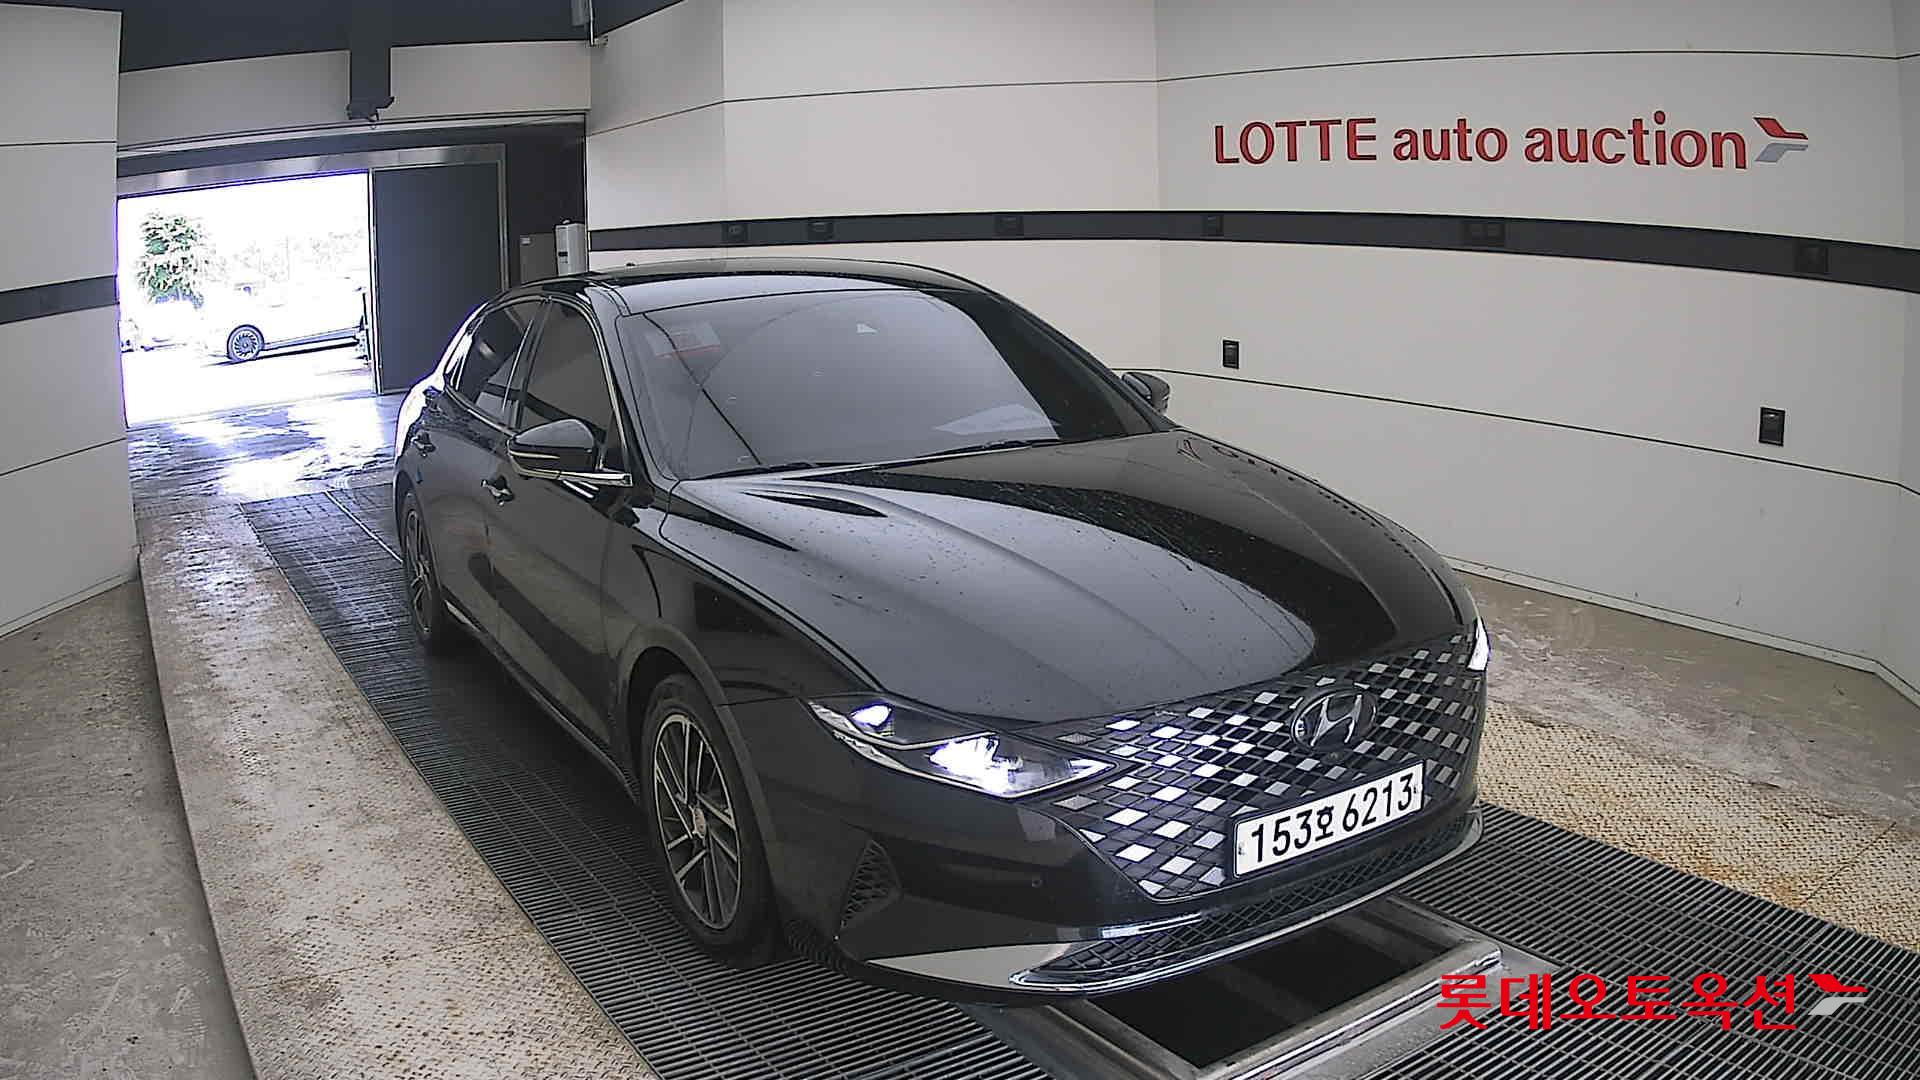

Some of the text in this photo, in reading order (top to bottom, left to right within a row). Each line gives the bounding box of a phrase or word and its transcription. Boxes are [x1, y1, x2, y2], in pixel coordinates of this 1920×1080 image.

[1215, 110, 1748, 170] LOTTE auto auction
